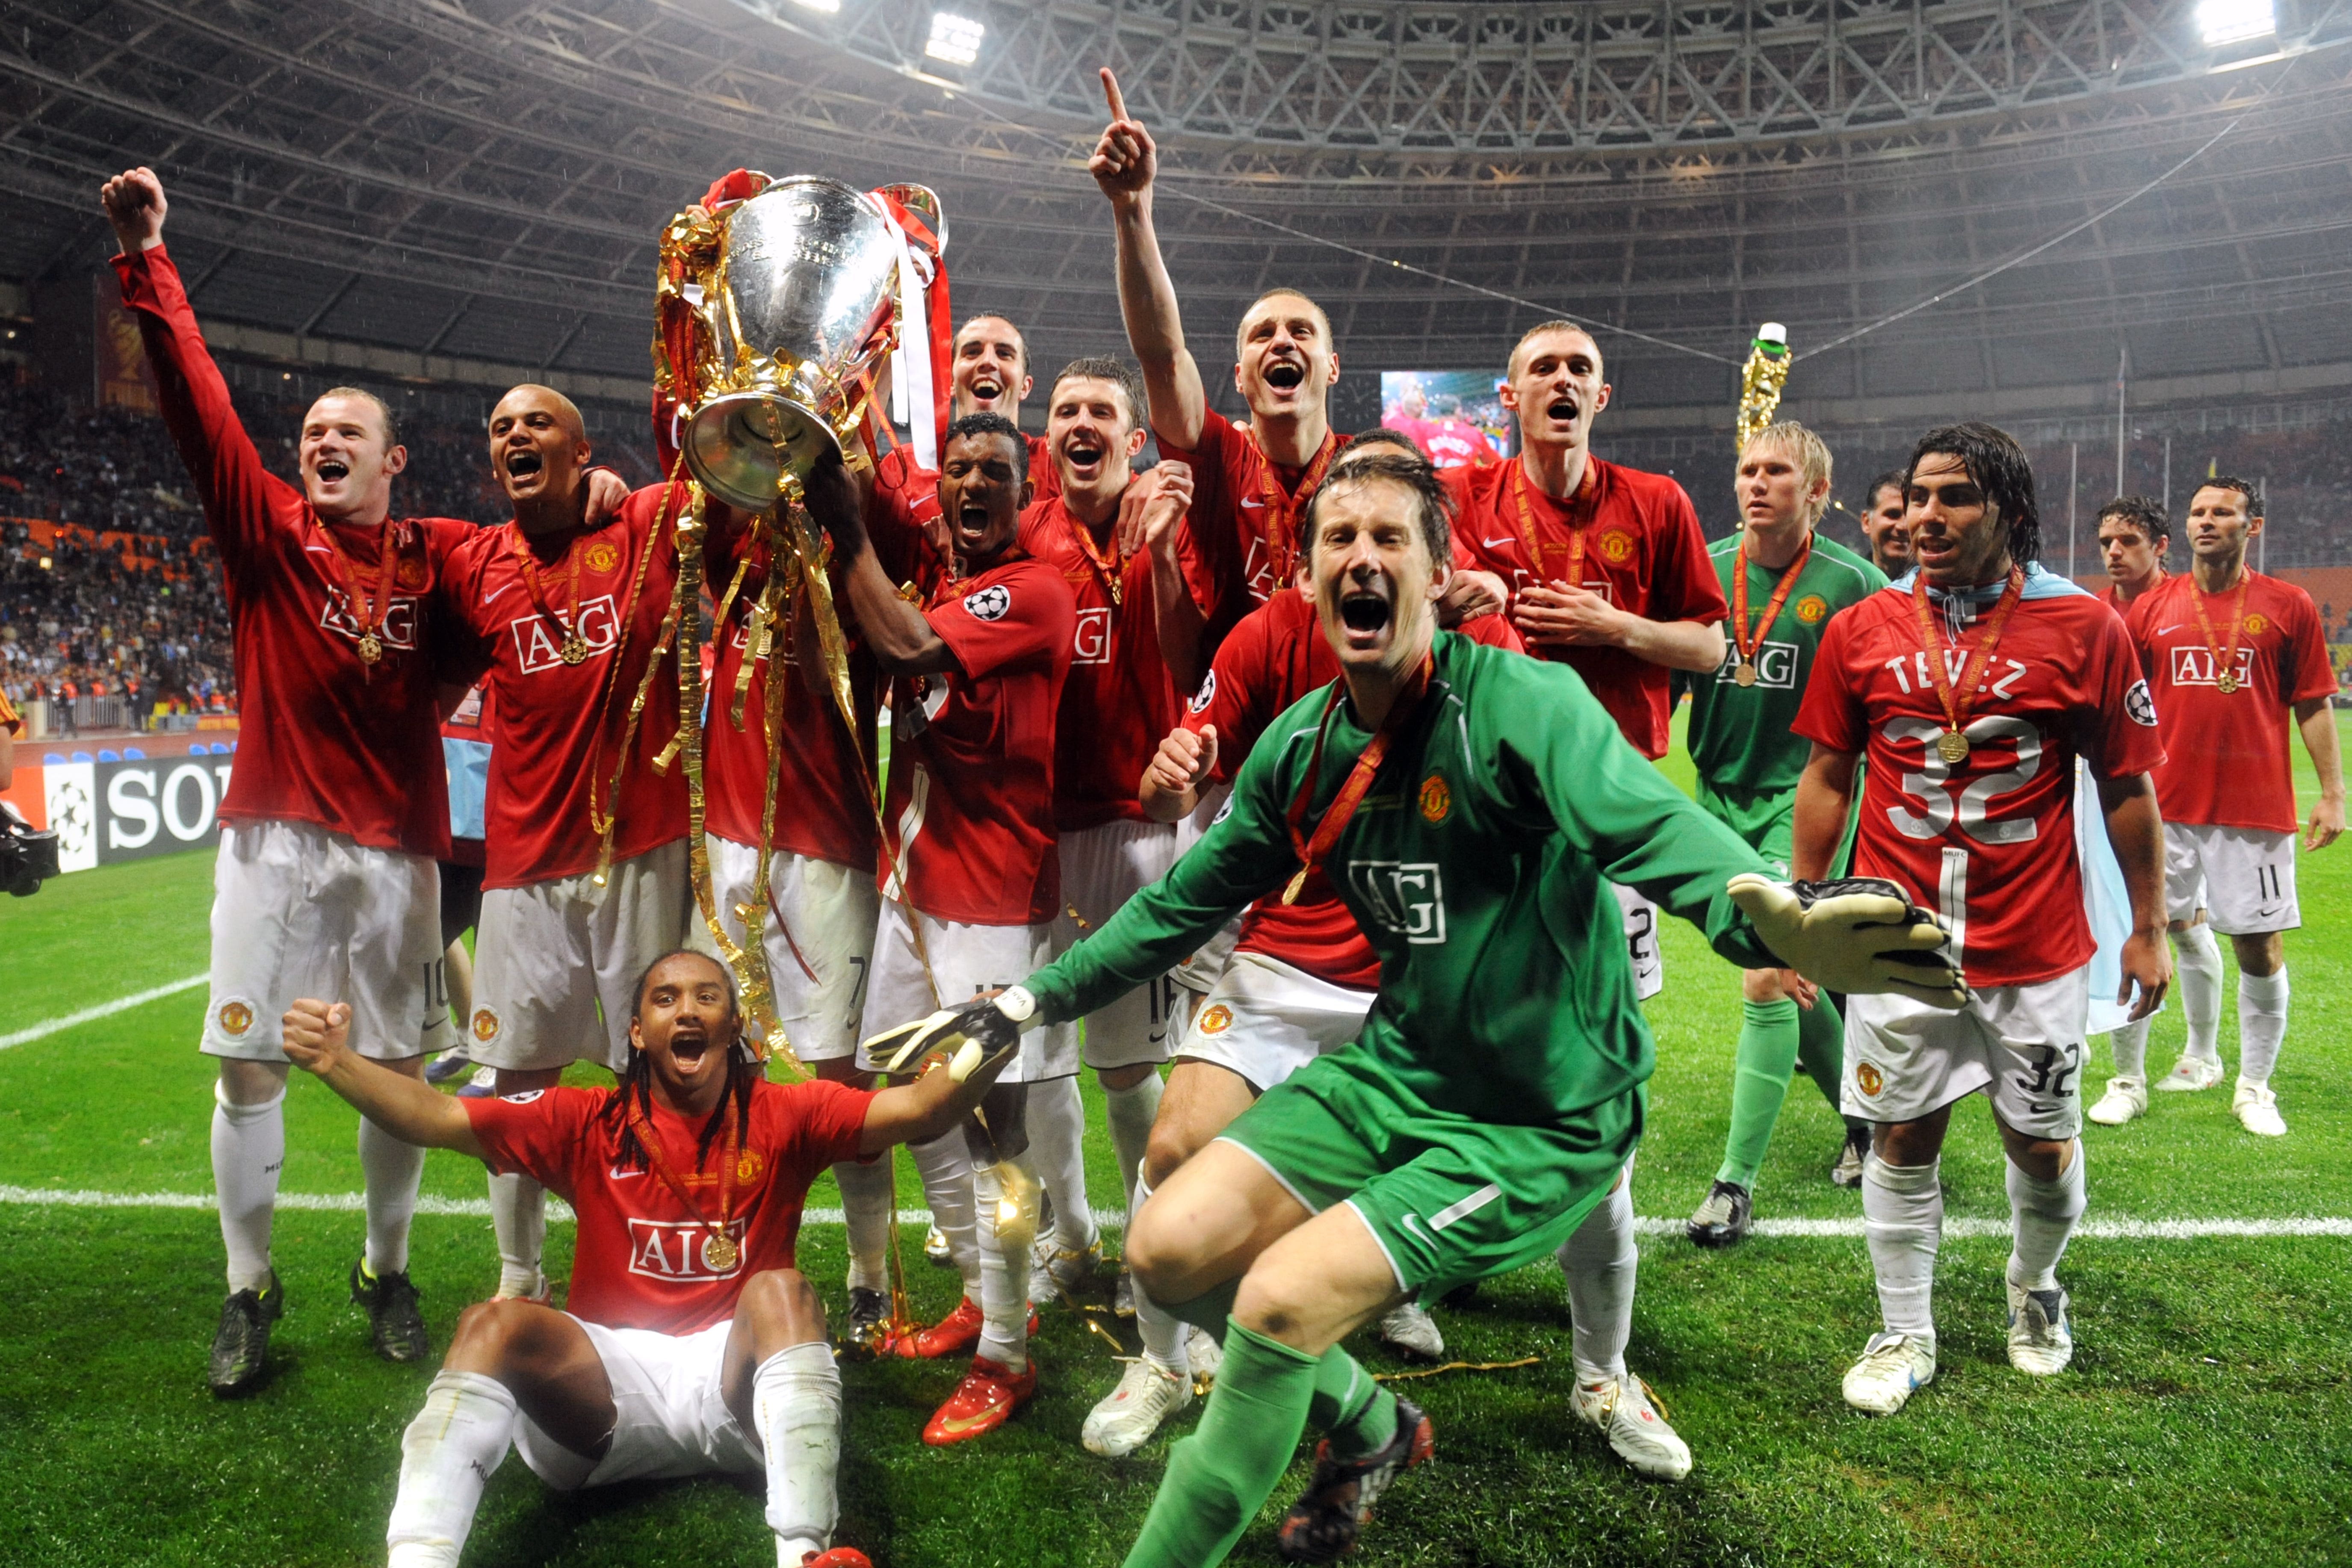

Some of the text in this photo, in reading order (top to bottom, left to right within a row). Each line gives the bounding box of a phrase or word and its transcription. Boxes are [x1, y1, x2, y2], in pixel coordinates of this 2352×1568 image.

[1882, 715, 2042, 844] 32
[2258, 864, 2281, 902] 11
[849, 956, 866, 1009] 7
[2017, 1042, 2079, 1098] 32
